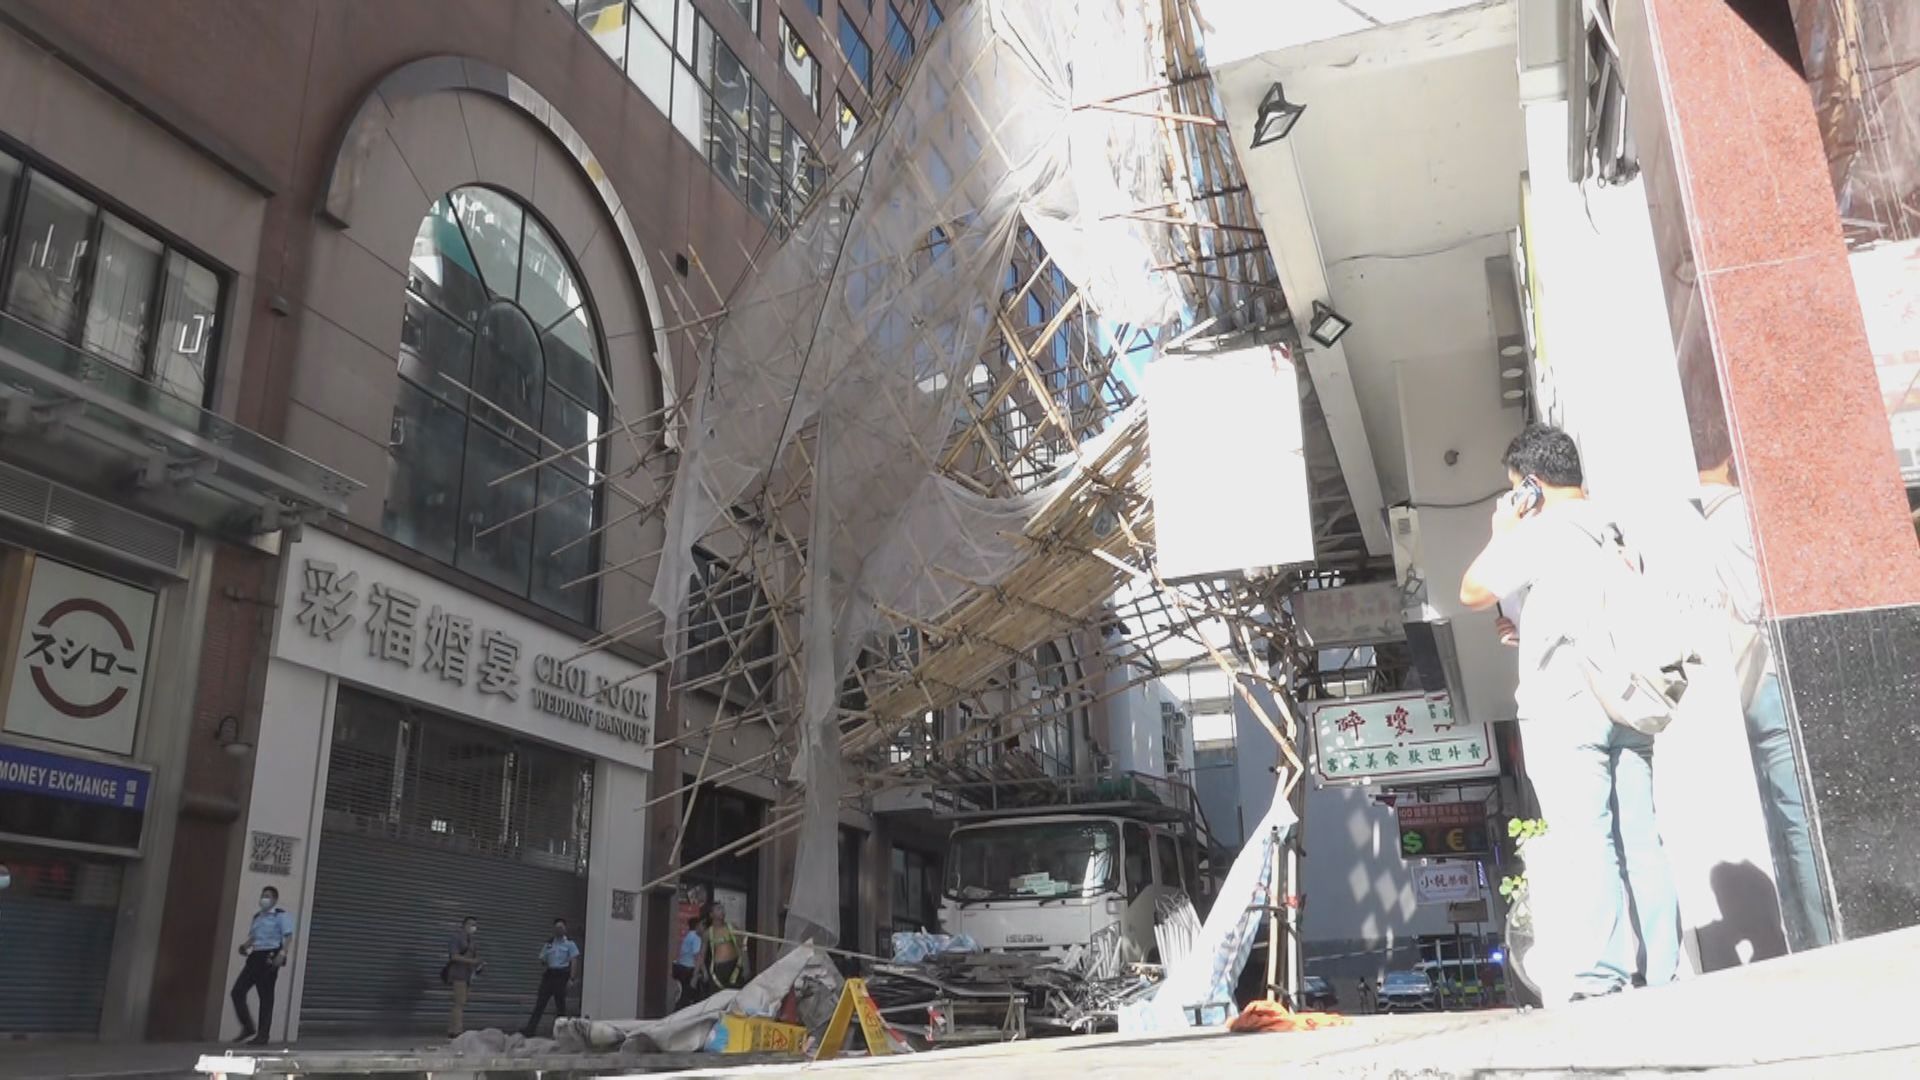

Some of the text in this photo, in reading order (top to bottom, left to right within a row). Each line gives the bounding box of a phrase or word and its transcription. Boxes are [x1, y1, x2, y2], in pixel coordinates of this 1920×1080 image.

[23, 632, 138, 675] スシロー
[296, 558, 522, 702] 彩福婚宴
[533, 653, 649, 720] CHOI FOOK
[531, 687, 650, 745] WEDDING BANQUET
[0, 760, 47, 787] MONEY
[48, 770, 118, 799] EXCHANGE
